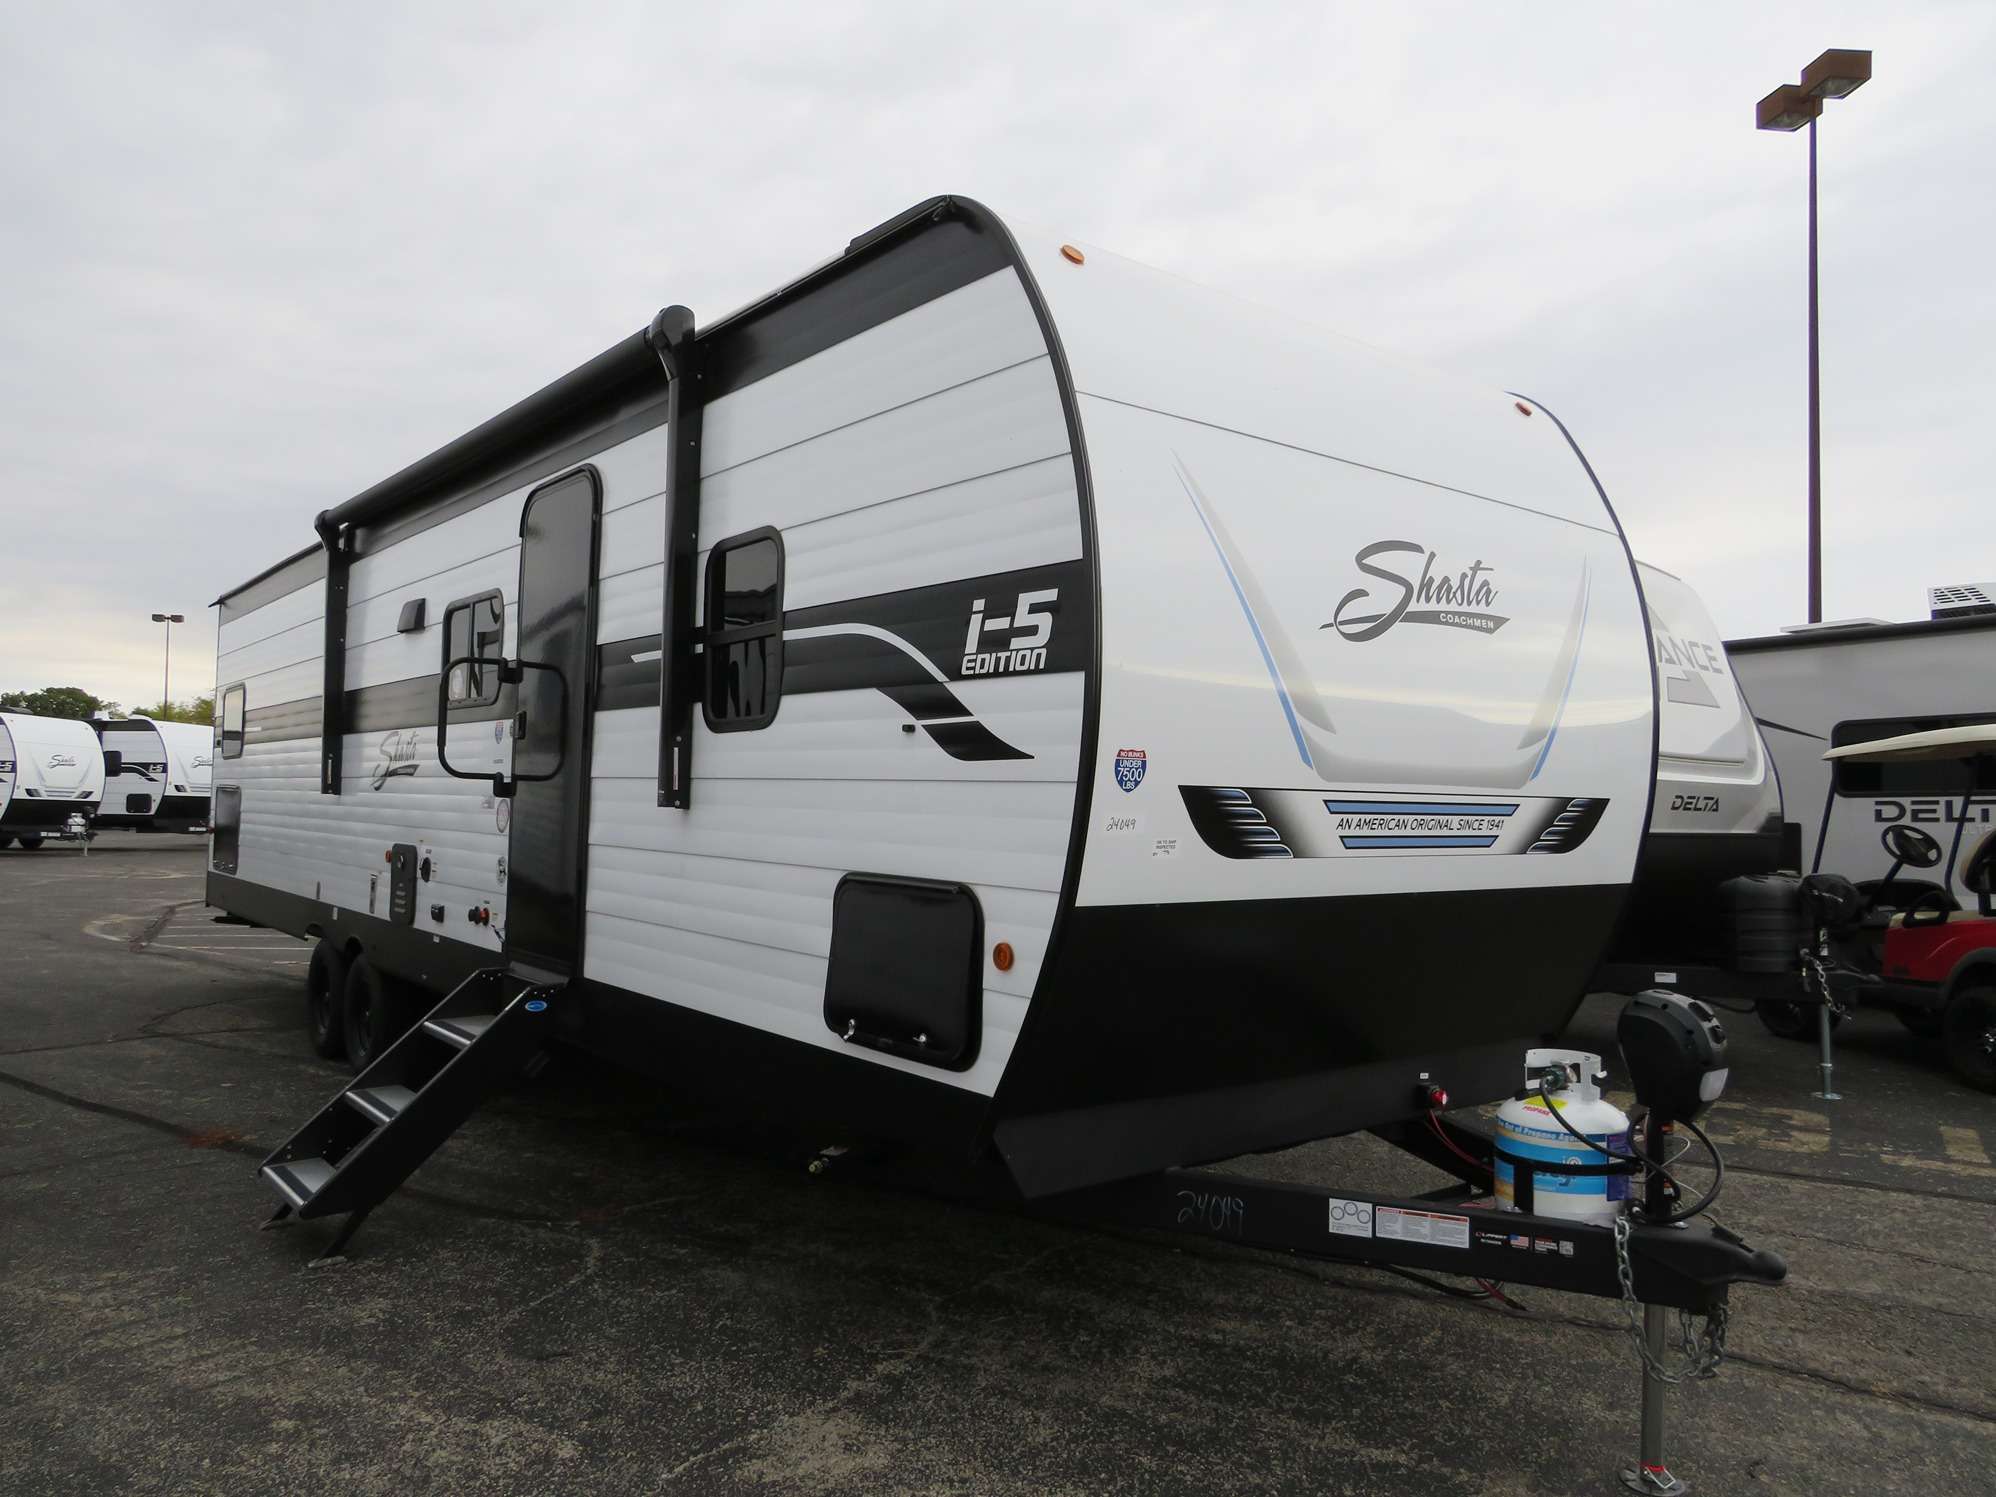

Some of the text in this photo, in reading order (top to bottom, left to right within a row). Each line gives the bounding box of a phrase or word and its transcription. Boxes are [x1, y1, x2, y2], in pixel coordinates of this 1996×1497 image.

[1334, 540, 1498, 642] Shasta
[965, 588, 1059, 654] i-5
[1440, 613, 1494, 629] COACHMEN
[961, 648, 1047, 675] EDITION
[1120, 760, 1142, 768] UNDER
[1117, 768, 1143, 781] 7500
[1122, 781, 1136, 790] LBS
[1671, 795, 1719, 812] DELTA
[1106, 817, 1137, 832] 24049
[1336, 818, 1505, 831] AN AMERICAN ORIGINAL SINCE 1941
[1176, 1190, 1244, 1237] 24049
